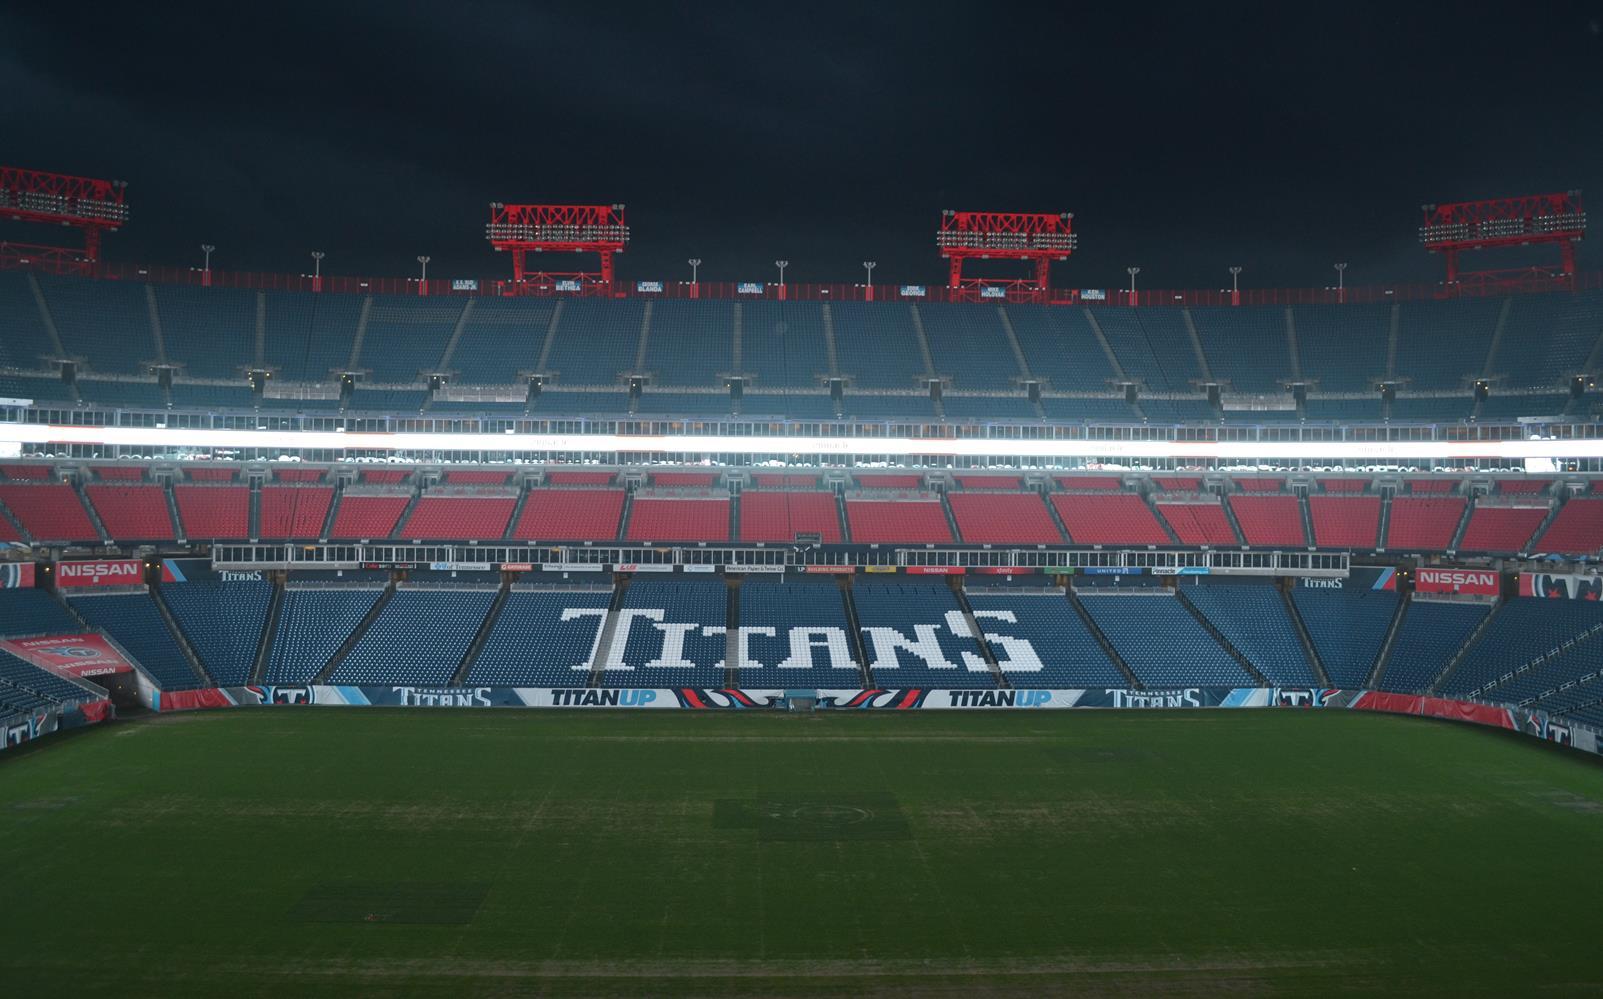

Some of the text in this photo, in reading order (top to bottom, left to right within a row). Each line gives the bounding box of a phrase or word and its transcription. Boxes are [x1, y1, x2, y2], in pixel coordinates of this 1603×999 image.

[61, 563, 138, 577] NISSAN
[218, 570, 262, 582] TITANS
[1301, 577, 1343, 588] TITANS
[1420, 571, 1494, 586] NISSAN
[22, 637, 85, 647] NISSAN
[560, 608, 1044, 672] TITANS
[57, 658, 119, 670] NISSAN
[81, 667, 116, 677] NISSAN
[393, 686, 491, 707] TITANS
[1105, 688, 1200, 708] TITANS
